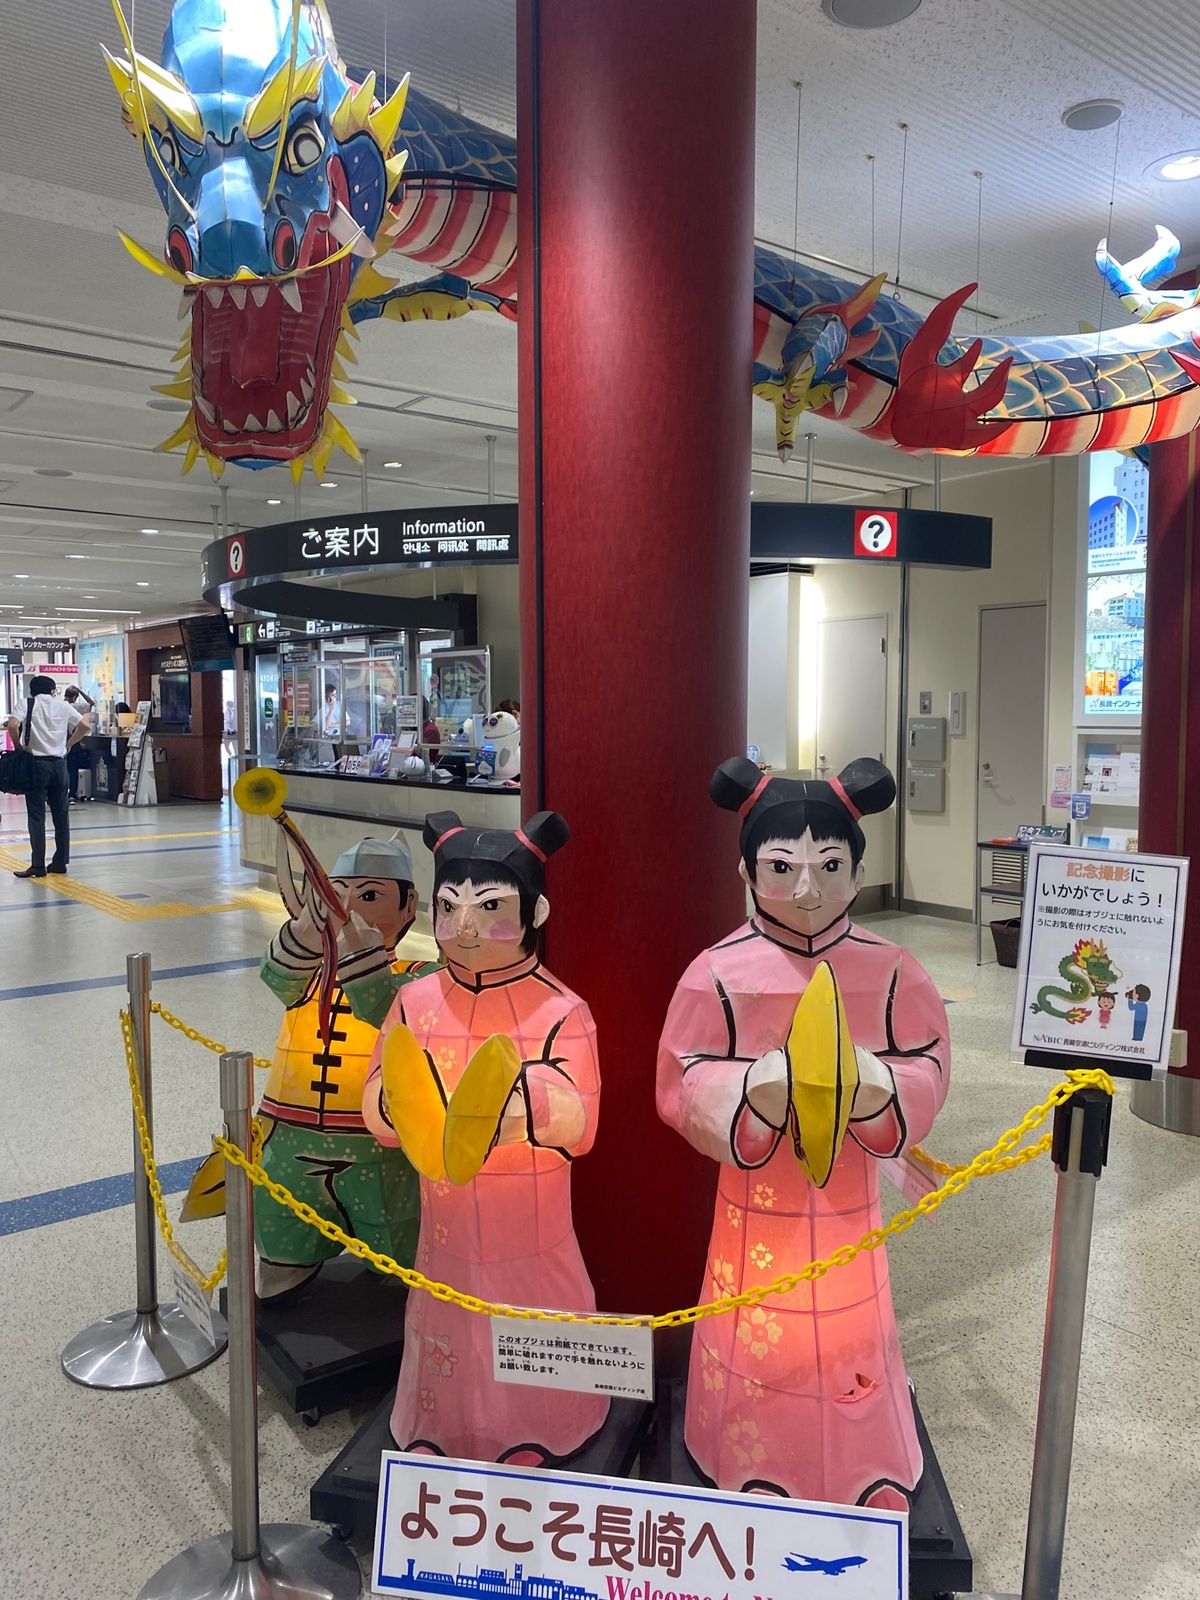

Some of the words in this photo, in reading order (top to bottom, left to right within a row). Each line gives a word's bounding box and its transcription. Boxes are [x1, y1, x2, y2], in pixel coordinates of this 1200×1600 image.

[403, 518, 485, 536] Information
[302, 523, 379, 559] ご案内
[403, 541, 431, 555] 안내소
[438, 540, 469, 553] 问讯处
[23, 640, 69, 649] レンタカーカウンター
[1066, 862, 1145, 882] 記念撮影に
[1042, 883, 1162, 908] いかがでしょう！
[1037, 918, 1127, 935] うにお気を付けください。
[1032, 1034, 1063, 1046] NABIC
[498, 1335, 632, 1355] このオブジェは和紙でできています。
[498, 1348, 645, 1370] 簡単に破れますので手を触れないように
[499, 1362, 559, 1375] お願い致します。
[401, 1481, 755, 1581] ようこそ長崎へ！
[419, 1573, 452, 1583] NAGASAKI
[605, 1575, 712, 1600] Welc
